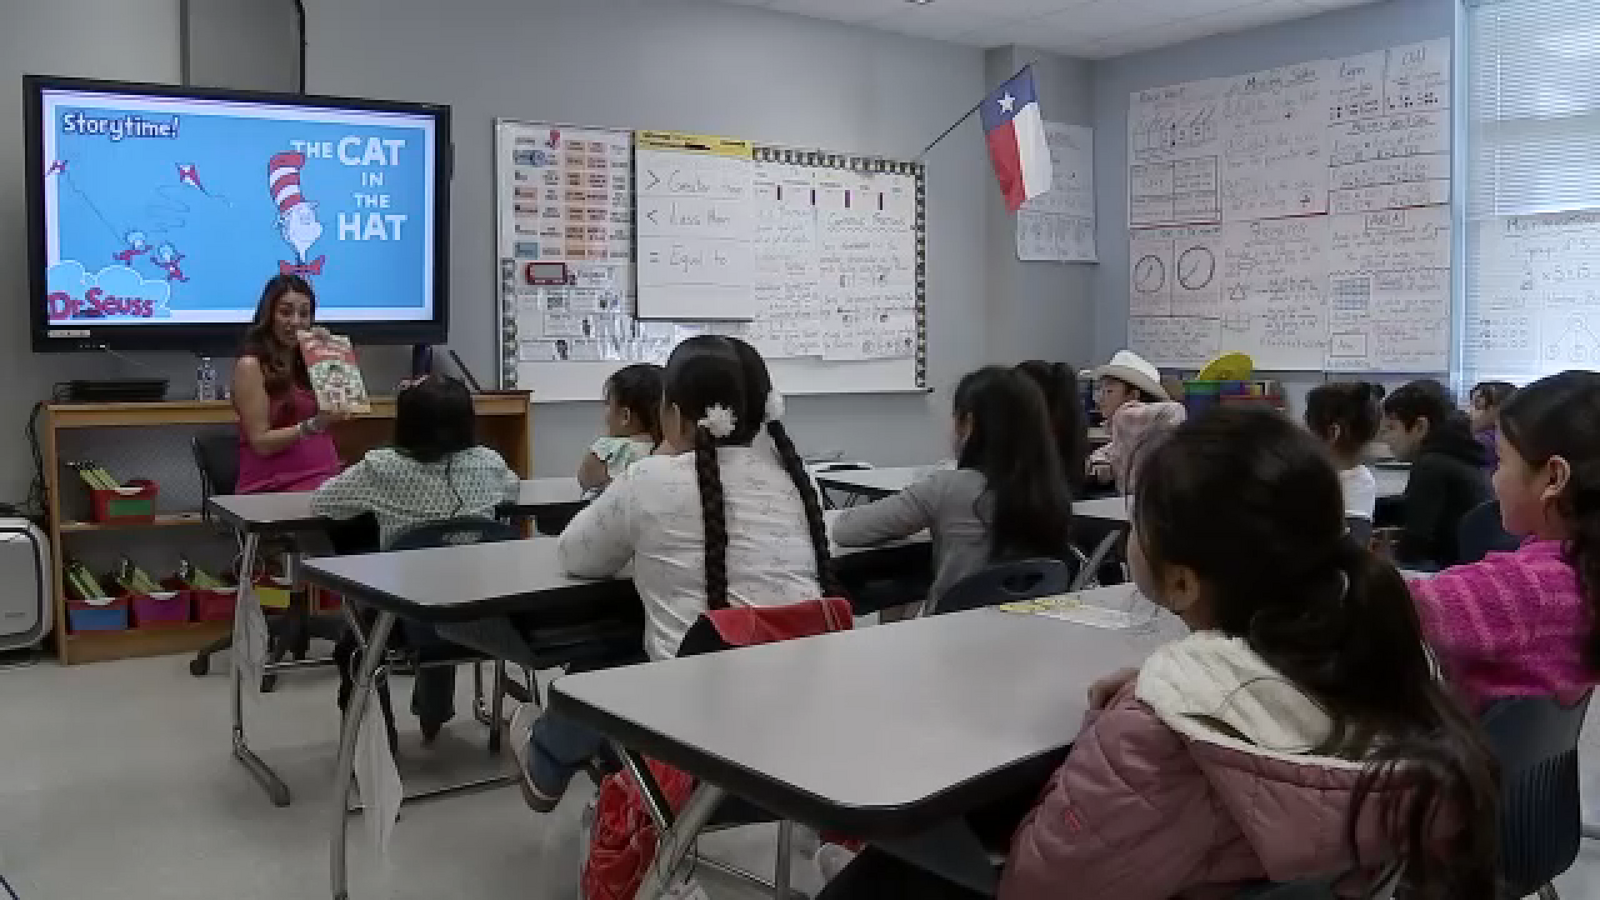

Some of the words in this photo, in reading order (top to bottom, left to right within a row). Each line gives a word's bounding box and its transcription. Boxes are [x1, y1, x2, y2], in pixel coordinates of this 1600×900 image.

[63, 112, 181, 141] Storytime!
[291, 139, 333, 159] THE
[337, 136, 406, 166] CAT
[361, 172, 384, 187] IN
[355, 193, 391, 209] THE
[338, 212, 408, 241] HAT
[669, 243, 704, 273] Equal
[714, 248, 729, 266] to
[85, 286, 157, 318] Seuss
